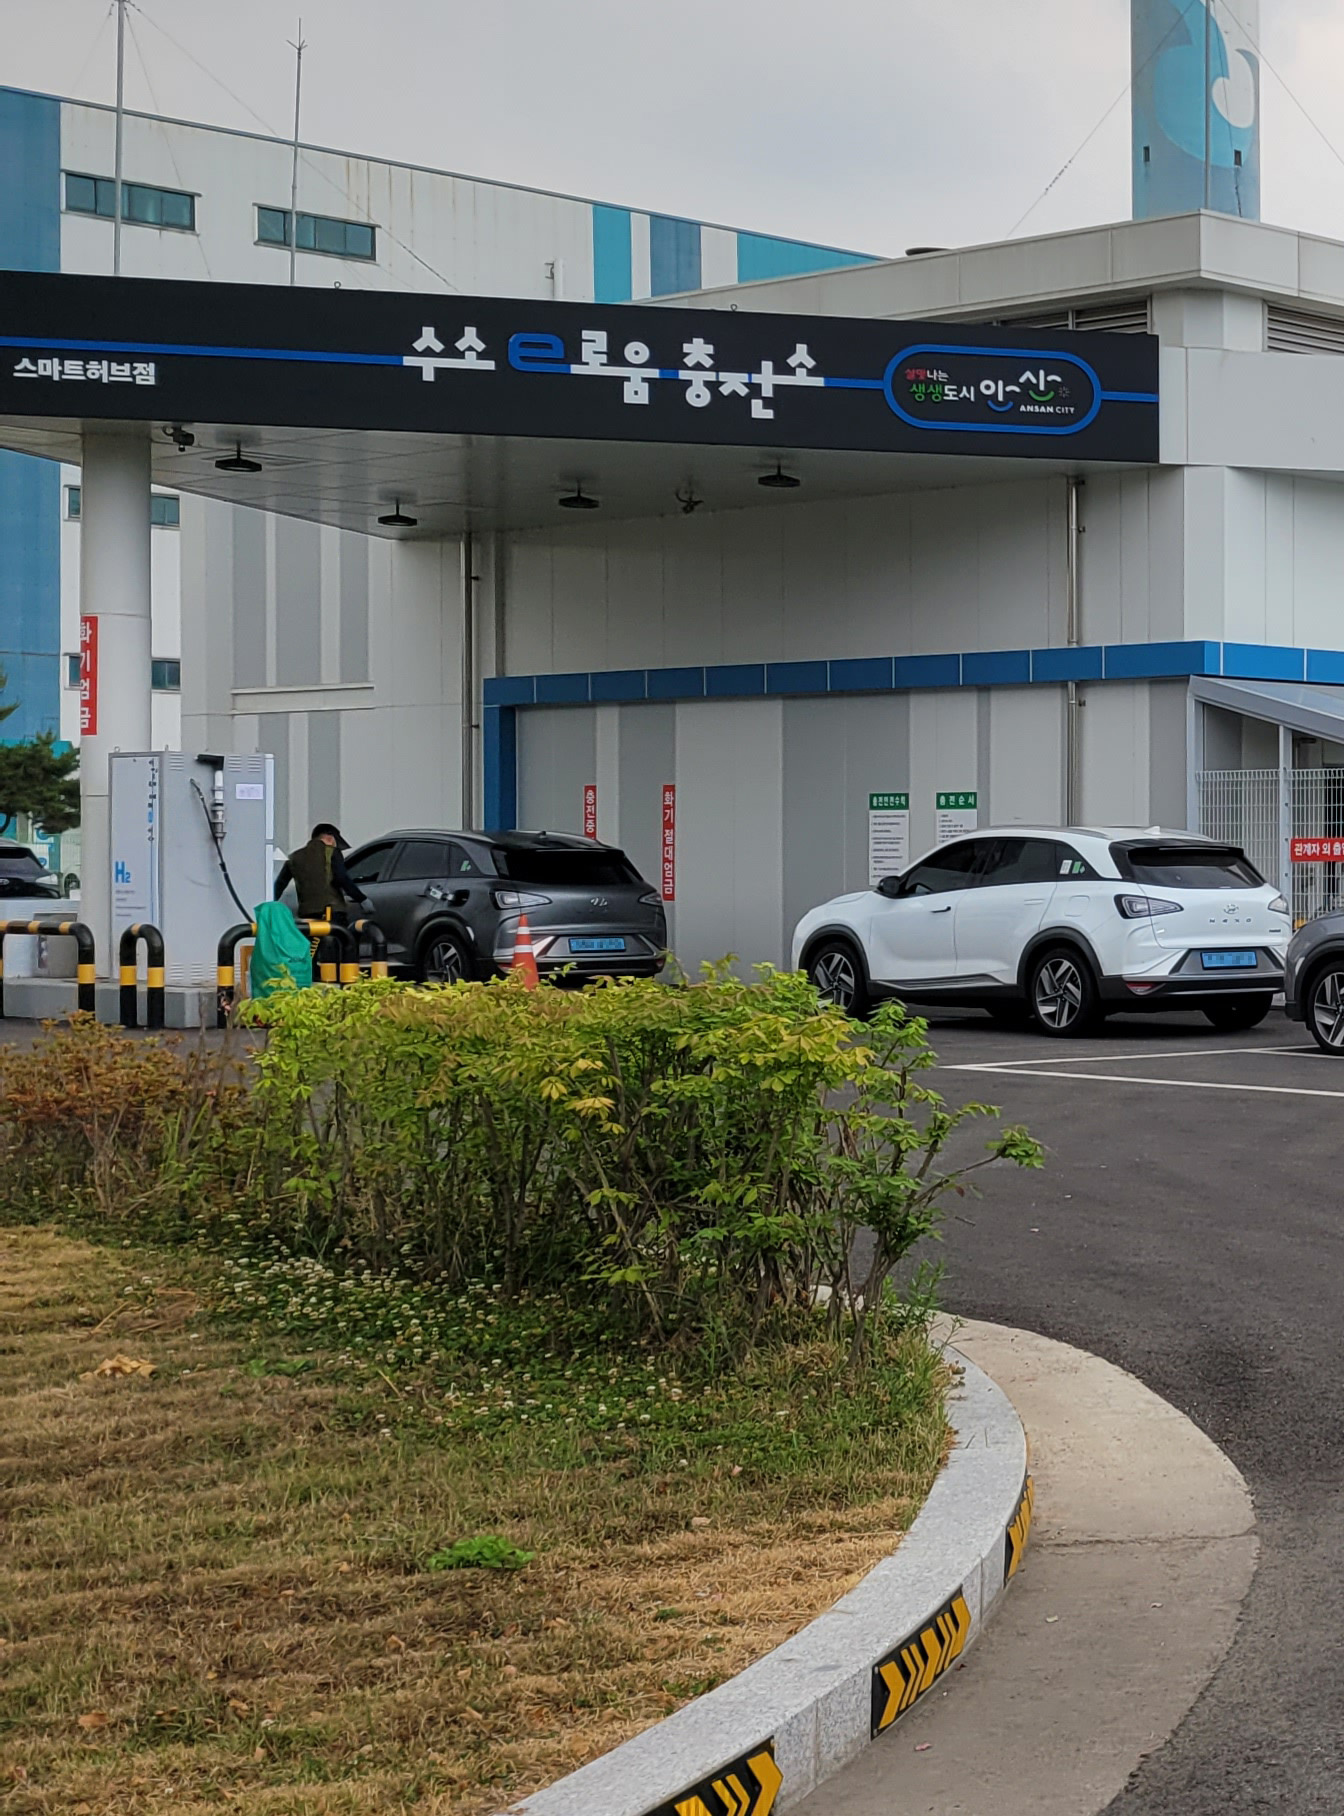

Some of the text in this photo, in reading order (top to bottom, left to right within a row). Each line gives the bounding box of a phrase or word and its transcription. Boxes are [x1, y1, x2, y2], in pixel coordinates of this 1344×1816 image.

[13, 356, 156, 386] 스마트허브점
[679, 337, 826, 419] 충전소
[909, 382, 975, 402] 생생도시
[1019, 404, 1076, 415] ANSAN CITY
[1294, 842, 1320, 856] 관계자
[1321, 842, 1331, 856] 외
[115, 860, 131, 884] H2
